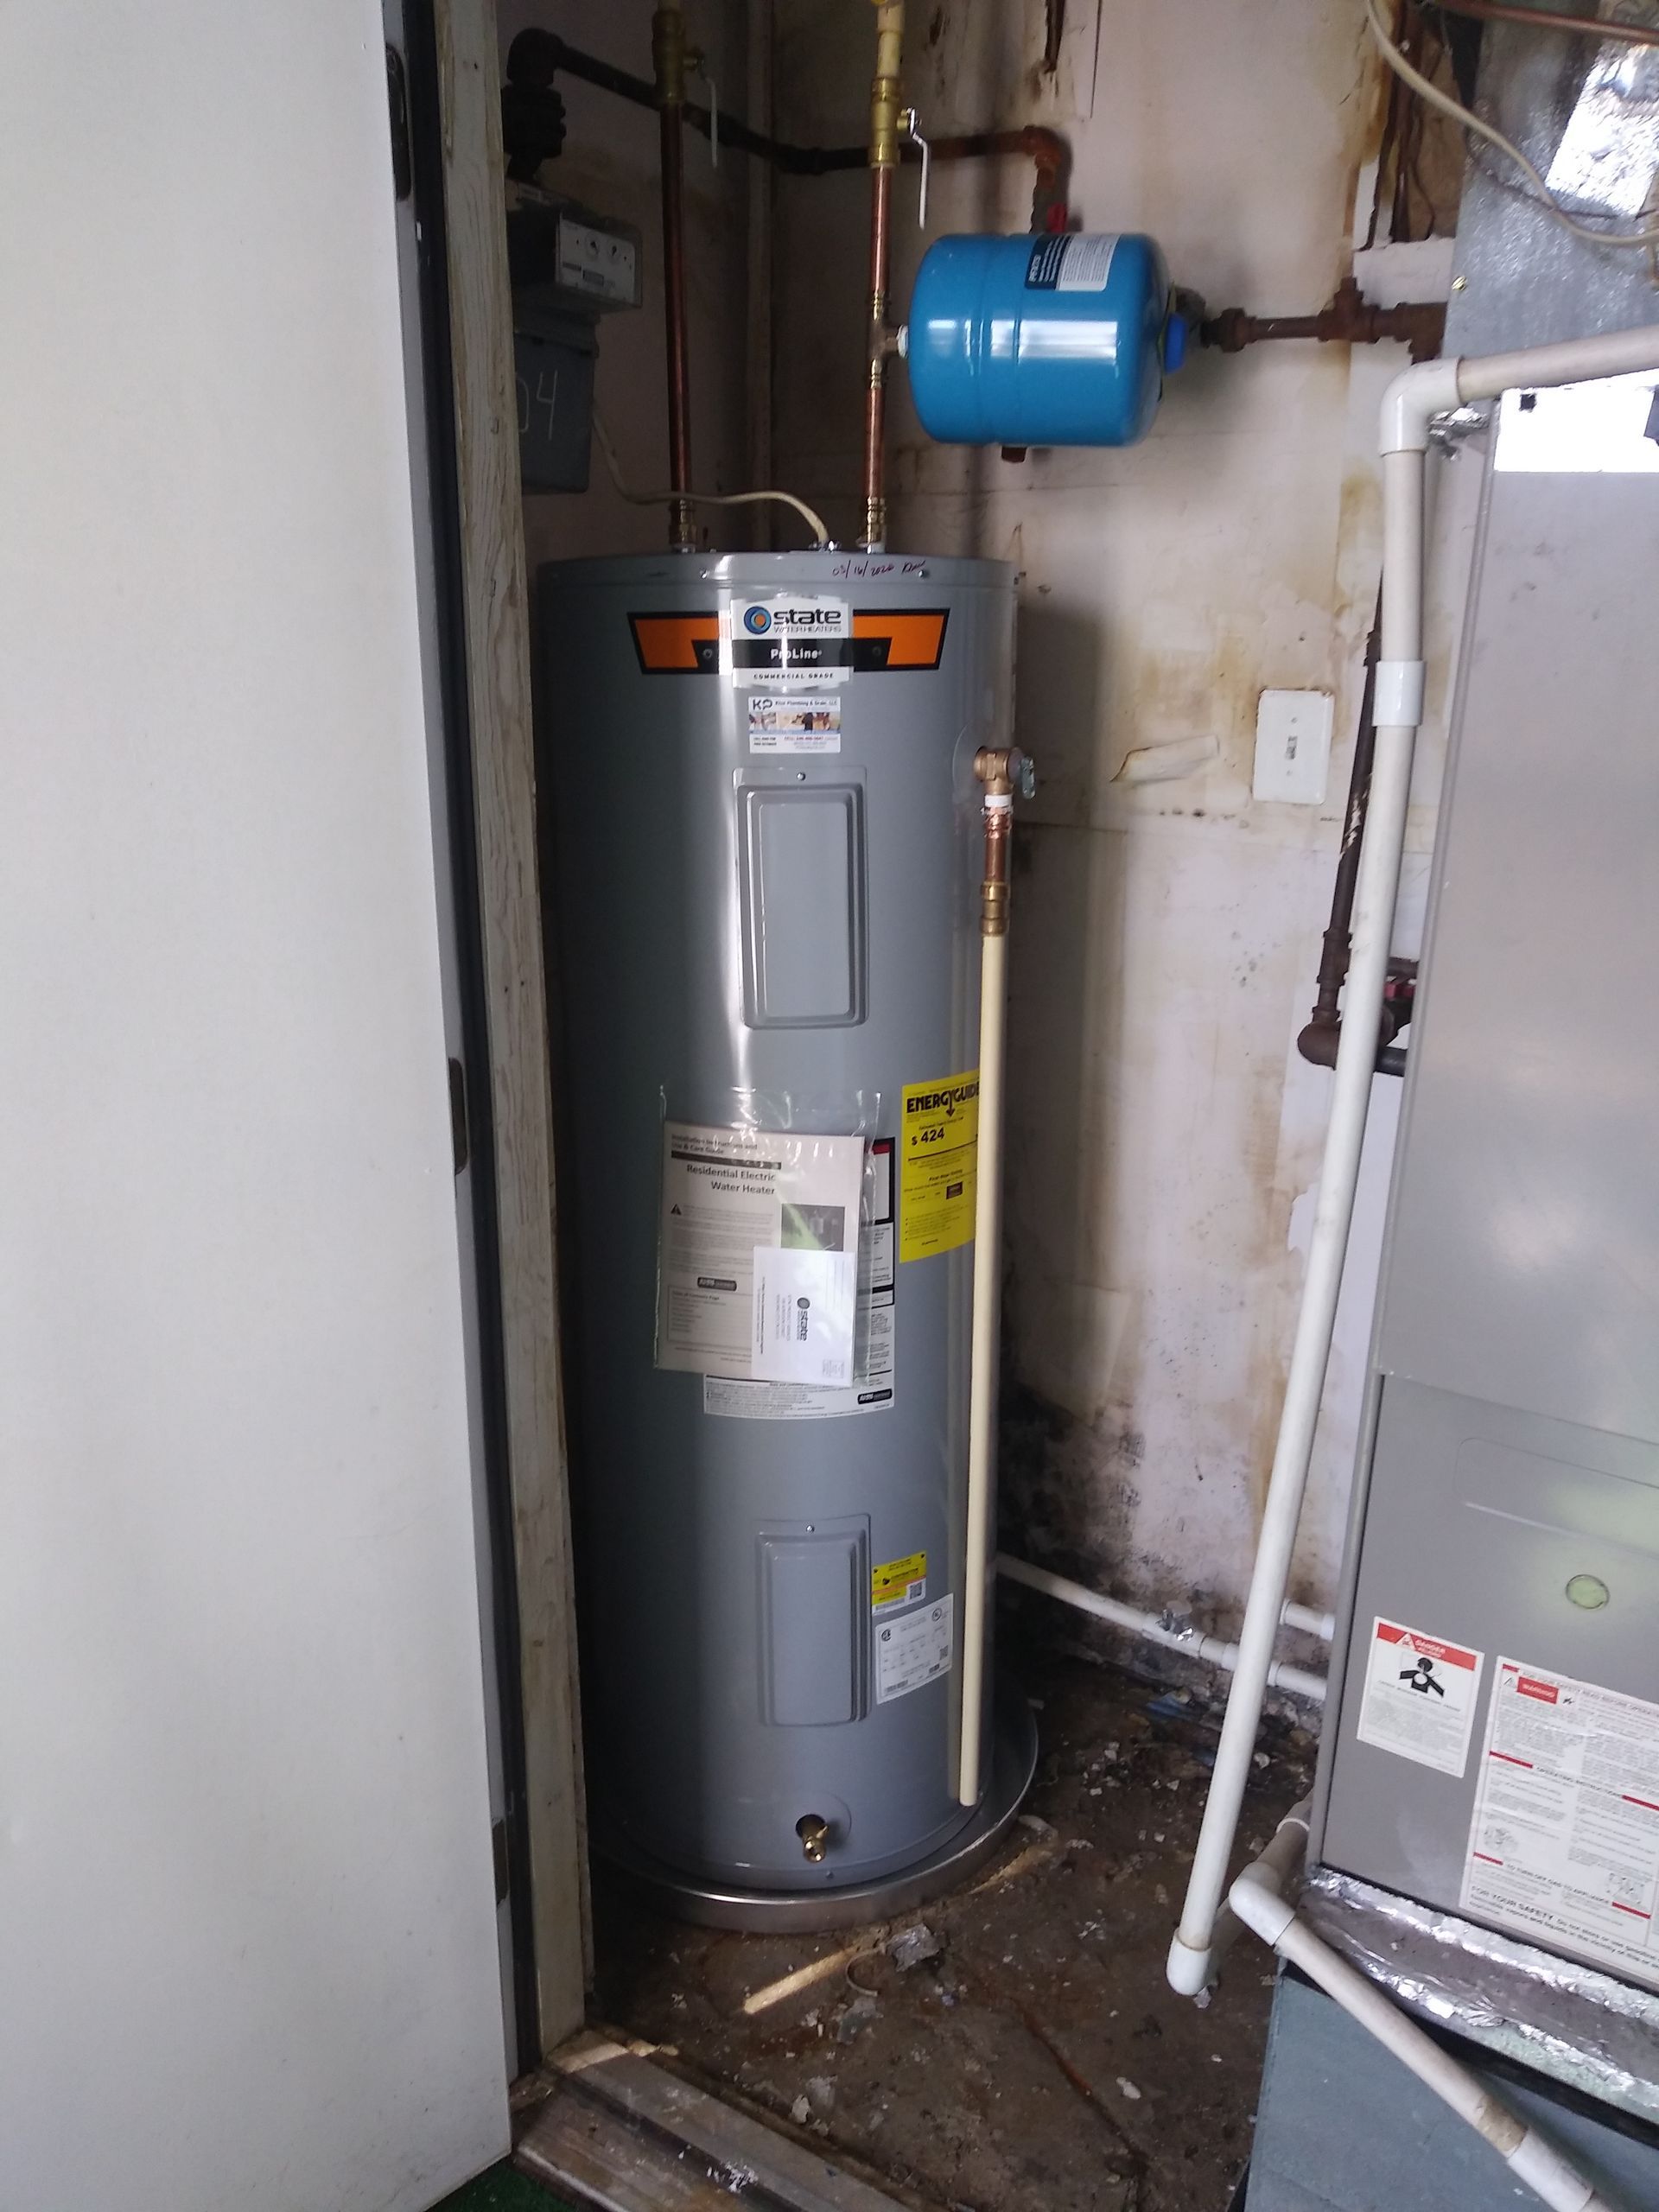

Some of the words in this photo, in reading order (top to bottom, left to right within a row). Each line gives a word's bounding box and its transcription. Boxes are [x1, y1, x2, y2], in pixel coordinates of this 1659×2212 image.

[773, 609, 842, 625] state
[912, 1136, 918, 1146] $
[921, 1127, 945, 1143] 424
[687, 1164, 738, 1179] Residential
[741, 1171, 776, 1182] Electric
[711, 1180, 740, 1192] Water
[742, 1184, 775, 1195] Heater
